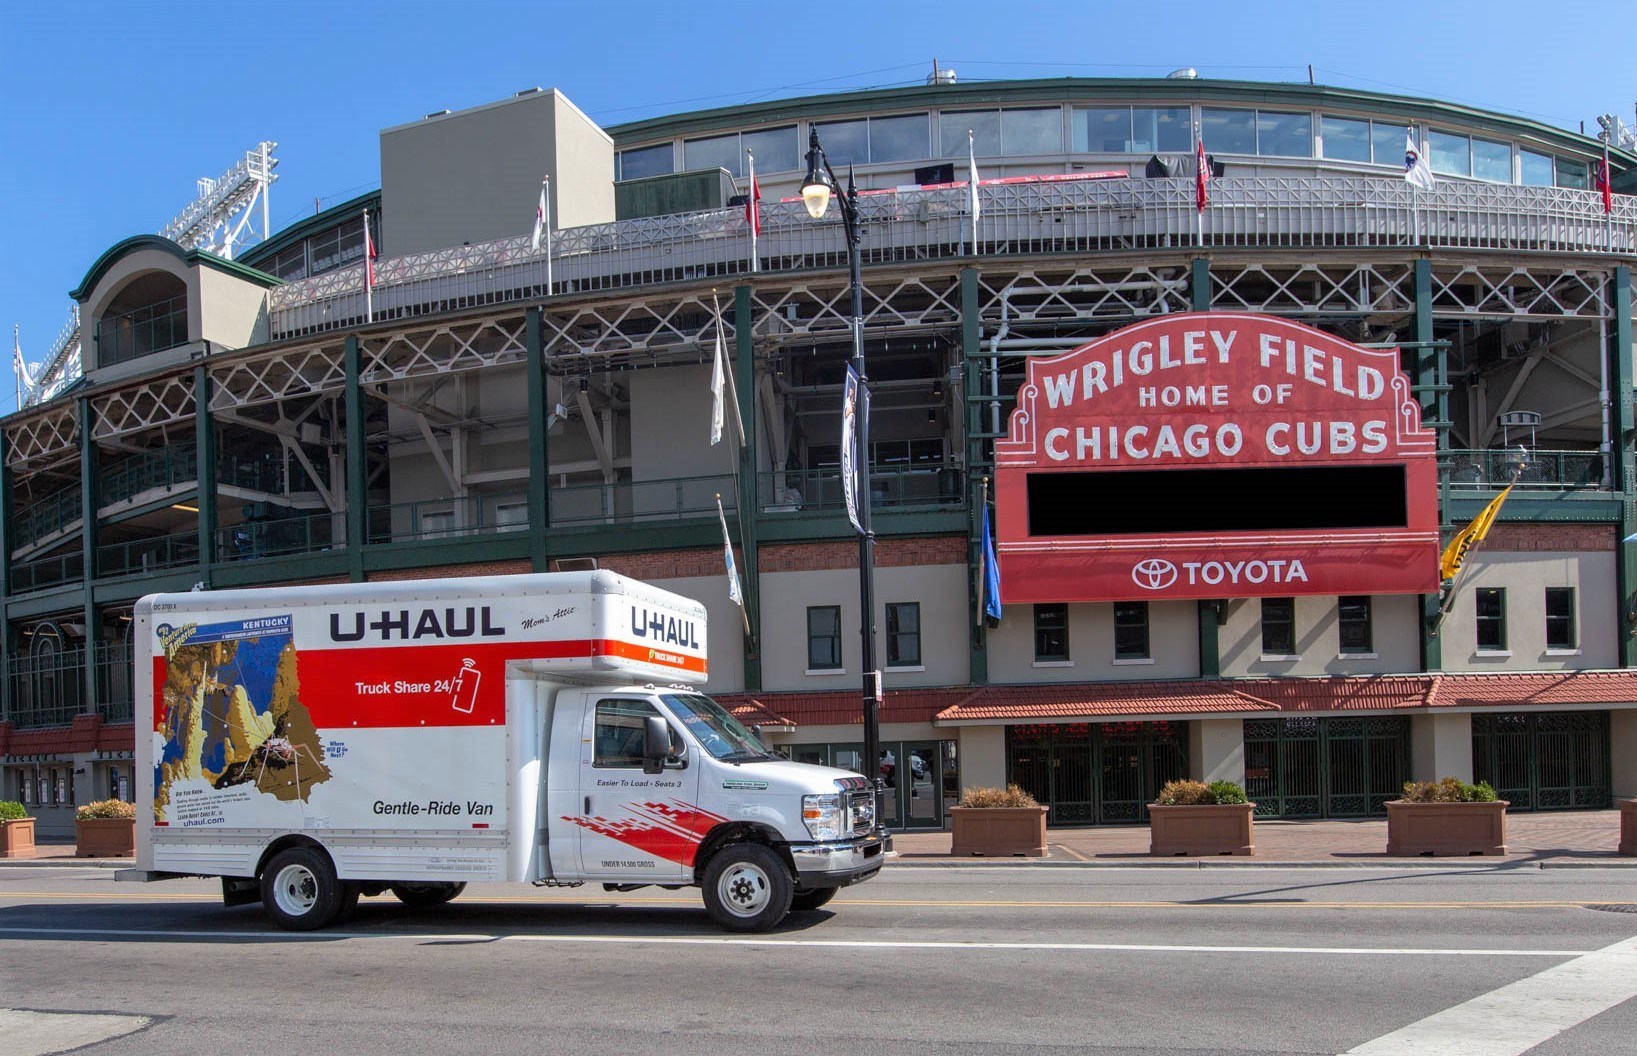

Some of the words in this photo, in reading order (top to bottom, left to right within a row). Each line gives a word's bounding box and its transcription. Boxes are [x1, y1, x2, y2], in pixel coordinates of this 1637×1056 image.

[1042, 329, 1237, 409] WRIGLEY
[1259, 332, 1385, 401] FIELD
[1138, 385, 1230, 408] HOME
[1252, 383, 1294, 405] OF
[1043, 422, 1243, 461] CHICAGO
[1264, 420, 1388, 456] CUBS
[1182, 559, 1309, 586] TOYOTA
[242, 617, 289, 630] KENTUCKY
[521, 614, 550, 630] Mom's
[551, 606, 576, 621] Attic
[355, 681, 391, 695] Truck
[394, 680, 431, 694] Share
[433, 676, 464, 694] 24/7
[630, 780, 649, 788] Load
[654, 780, 676, 788] Seats
[373, 800, 461, 815] Gentle-Ride
[466, 801, 494, 815] Van
[183, 817, 225, 827] uhaul.com
[601, 860, 620, 868] UNDER
[637, 860, 656, 868] GROSS
